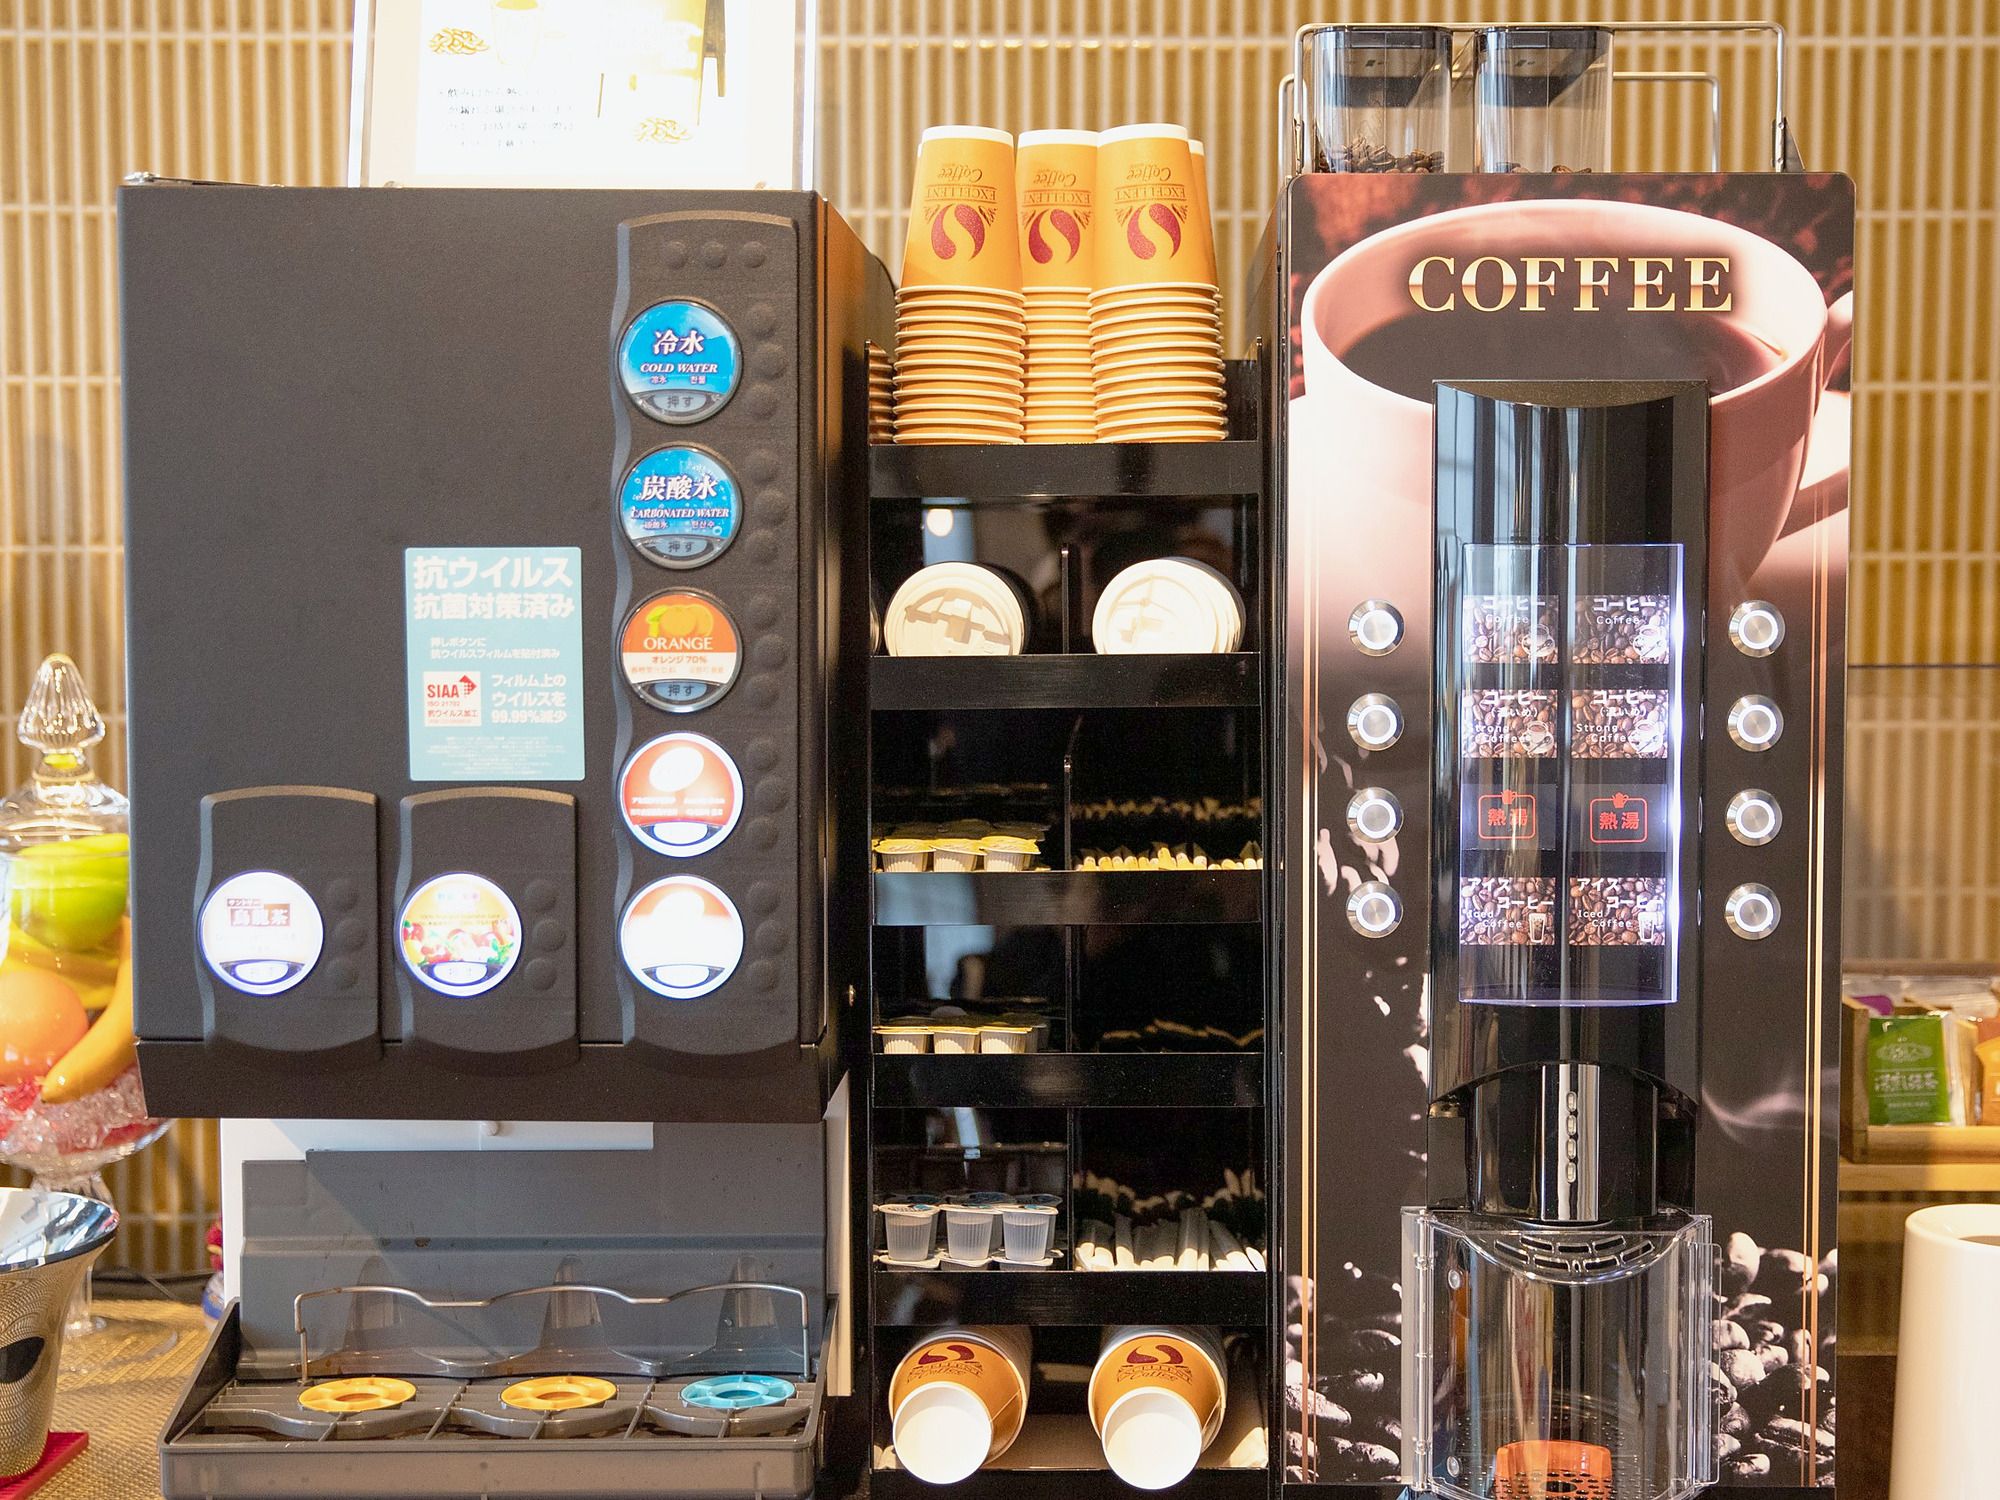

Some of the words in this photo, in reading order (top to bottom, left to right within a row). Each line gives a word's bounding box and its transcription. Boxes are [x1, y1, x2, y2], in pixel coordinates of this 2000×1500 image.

[937, 166, 983, 184] Coffee
[1033, 170, 1077, 188] Coffee
[1126, 165, 1172, 183] Coffee
[1408, 256, 1732, 311] COFFEE
[653, 329, 704, 355] 冷水
[640, 363, 674, 373] COLD
[677, 363, 718, 373] WATER
[667, 395, 694, 408] 押す
[641, 474, 718, 501] 炭酸水
[631, 507, 695, 518] CARBONATED
[697, 508, 729, 518] WATER
[668, 541, 694, 553] 押す
[413, 555, 574, 589] 抗ウイルス
[414, 593, 575, 620] 抗菌対策済み
[1483, 596, 1546, 611] コーヒー
[1593, 596, 1657, 611] コーヒー
[1485, 614, 1529, 624] Coffee
[1596, 615, 1640, 625] Coffee
[643, 636, 713, 651] ORANGE
[651, 655, 683, 665] オレンジ
[491, 674, 567, 687] フィルム上の
[427, 684, 460, 698] SIAA
[668, 685, 694, 697] 押す
[1481, 690, 1547, 705] コーヒー
[1593, 690, 1657, 705] コーヒー
[491, 692, 567, 708] ウイルスを
[491, 708, 568, 724] 99.99%減少
[1576, 723, 1618, 734] Strong
[1488, 808, 1529, 827] 熱湯
[1599, 811, 1640, 830] 熱湯
[1467, 878, 1511, 891] アイス
[1577, 878, 1621, 891] アイス
[1497, 896, 1554, 910] コーヒー
[1606, 896, 1663, 910] コーヒー
[1467, 910, 1494, 918] Iced
[1578, 910, 1604, 918] Iced
[1483, 919, 1523, 928] Coffee
[1592, 919, 1632, 928] Coffee
